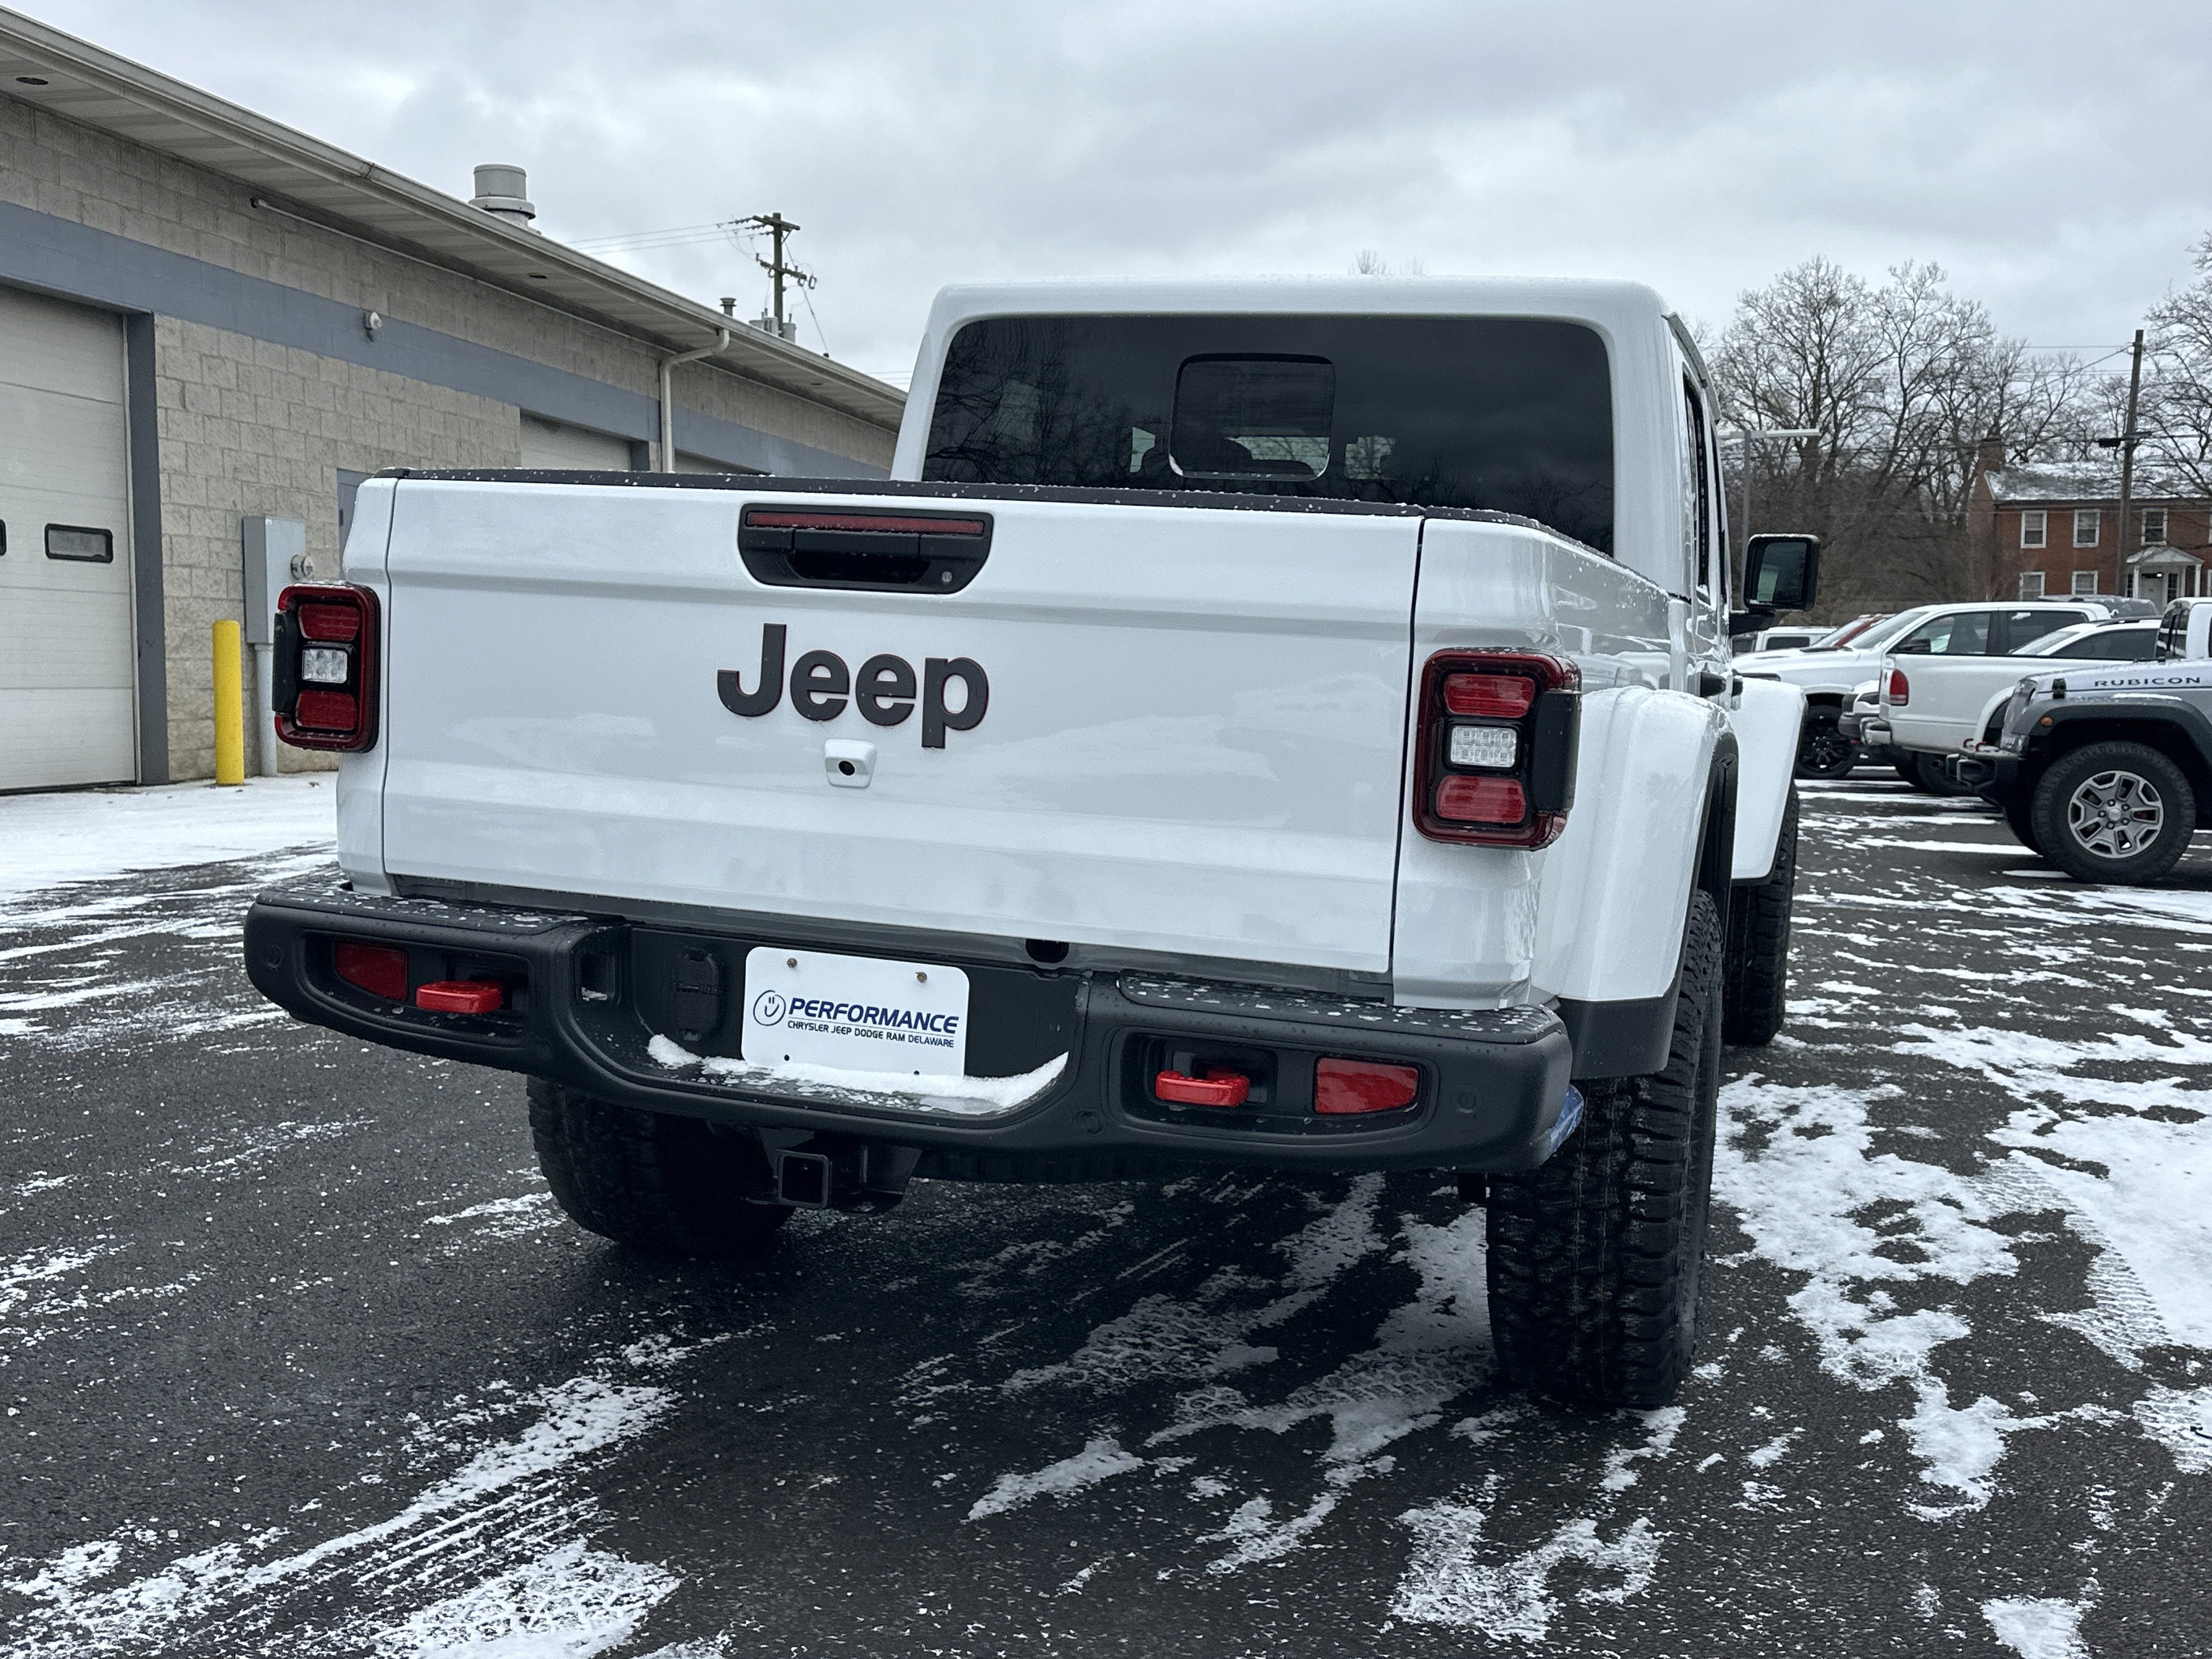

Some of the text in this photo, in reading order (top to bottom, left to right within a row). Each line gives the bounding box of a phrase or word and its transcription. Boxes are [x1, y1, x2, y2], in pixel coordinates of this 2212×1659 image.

[717, 623, 989, 749] Jeep
[2095, 677, 2200, 687] RUBICON
[788, 997, 959, 1034] PERFORMANCE
[787, 1020, 954, 1048] CHRYSLER JEEP DODGE RAM DELAWARE
